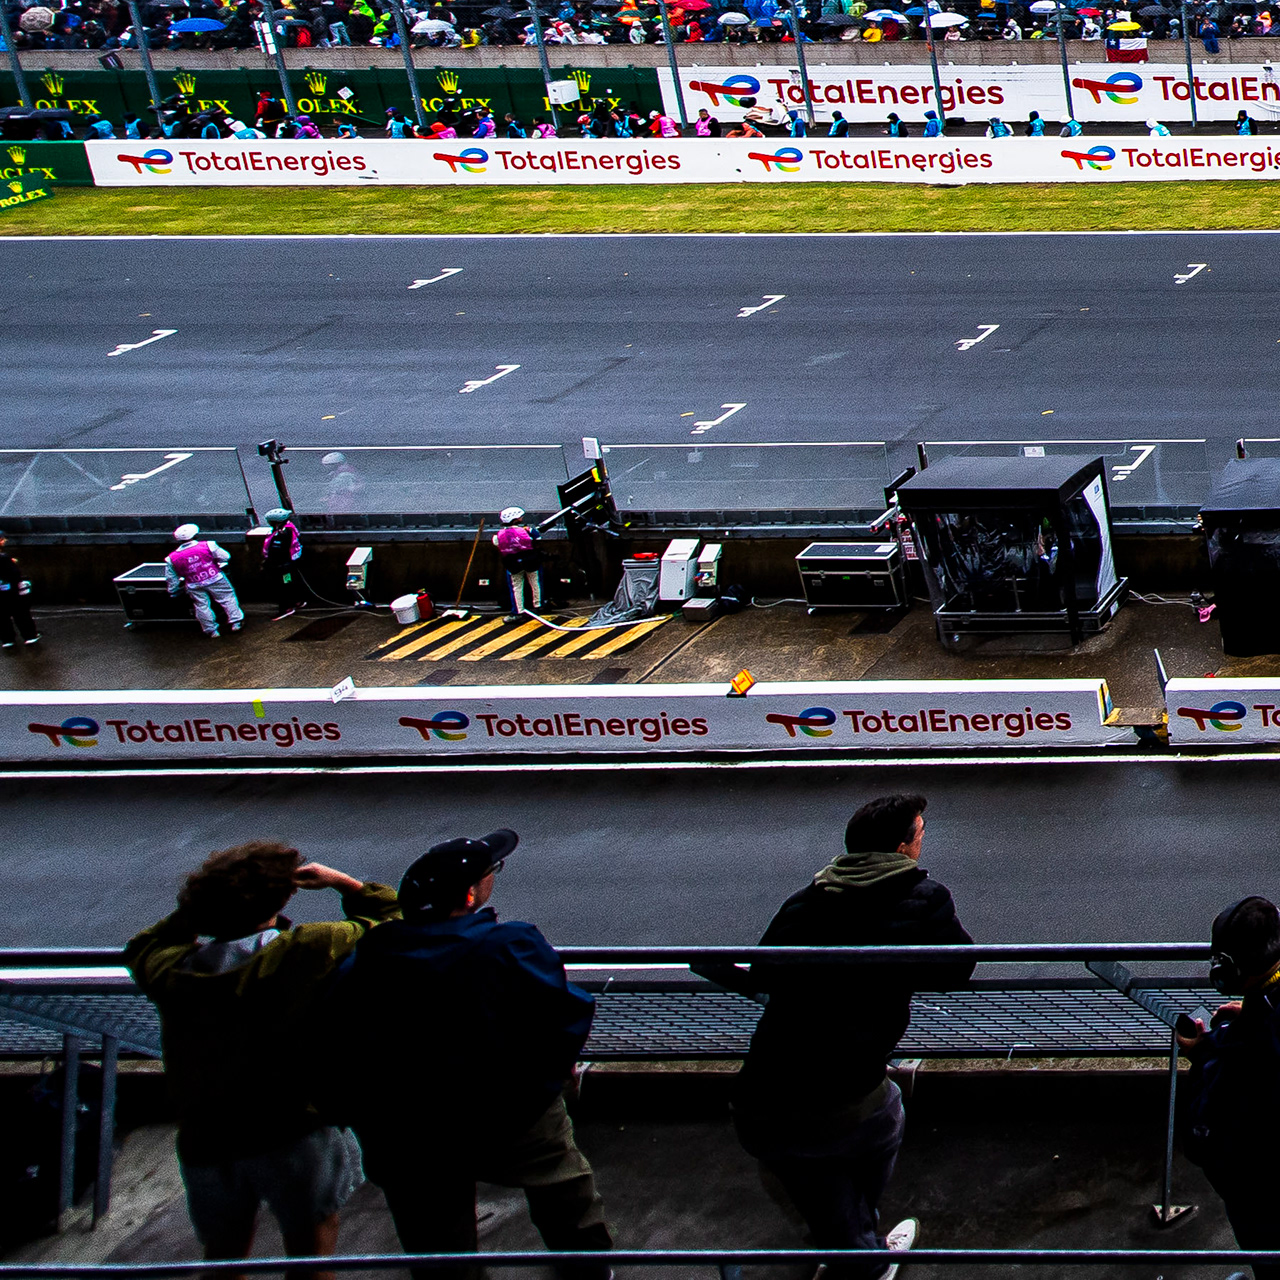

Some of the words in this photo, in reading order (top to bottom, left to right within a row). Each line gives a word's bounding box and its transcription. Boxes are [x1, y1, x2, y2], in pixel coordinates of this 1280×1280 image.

[768, 77, 1004, 111] TotalEnergies
[179, 151, 366, 176] TotalEnergies
[495, 150, 680, 175] TotalEnergies
[811, 148, 992, 173] TotalEnergies
[105, 716, 341, 747] TotalEnergies
[475, 712, 708, 742] TotalEnergies
[842, 707, 1071, 737] TotalEnergies
